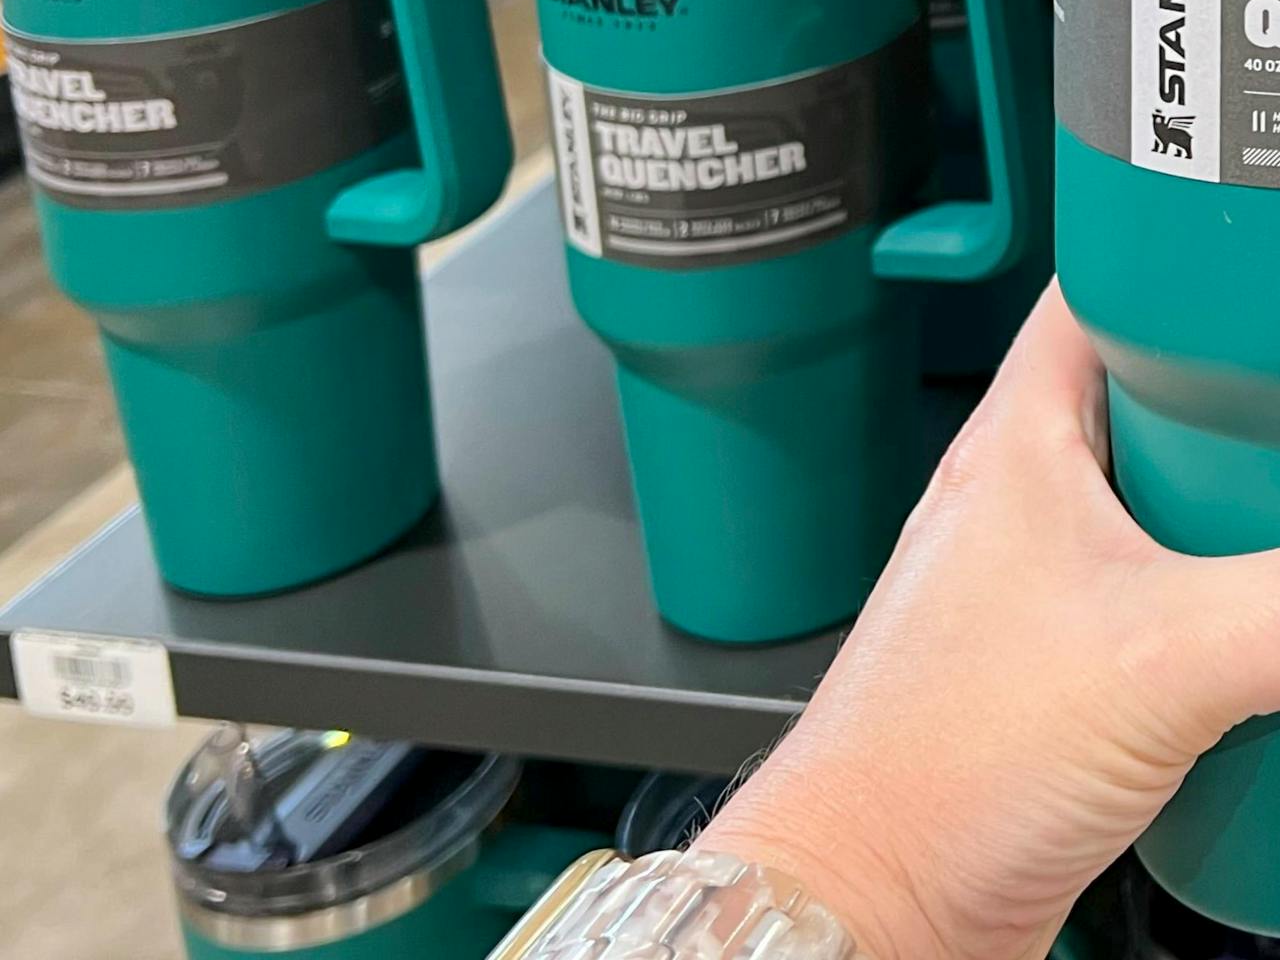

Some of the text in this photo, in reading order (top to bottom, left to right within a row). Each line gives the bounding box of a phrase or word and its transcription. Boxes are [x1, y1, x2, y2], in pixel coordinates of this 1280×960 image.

[1244, 58, 1262, 72] 40
[595, 121, 738, 160] TRAVEL
[600, 141, 807, 190] QUENCHER
